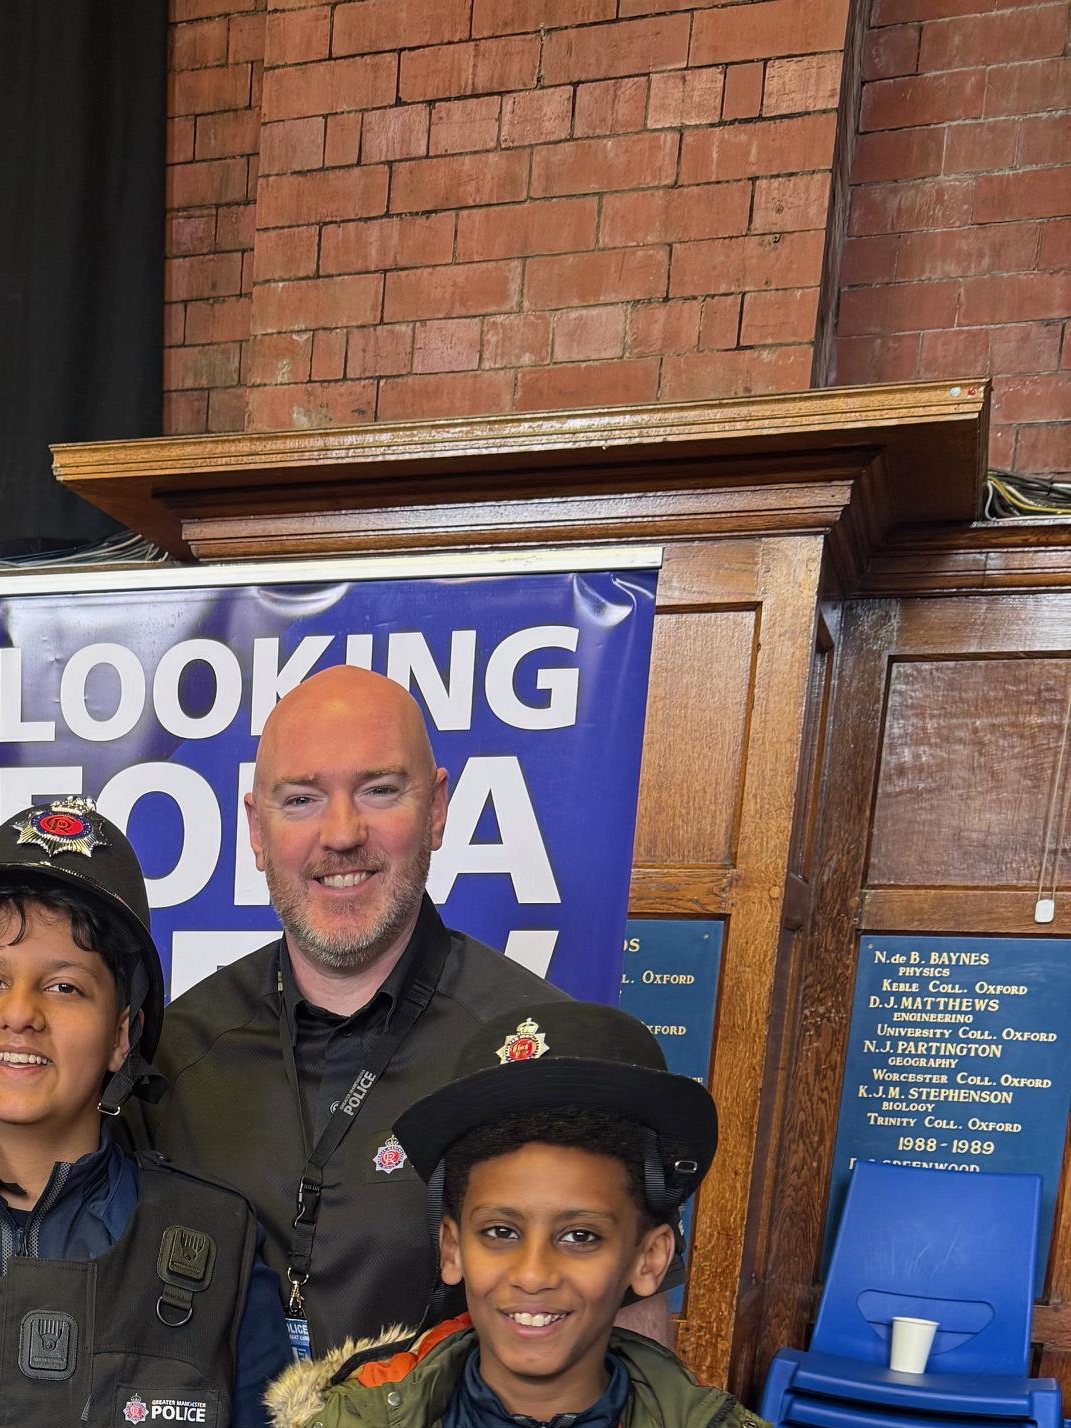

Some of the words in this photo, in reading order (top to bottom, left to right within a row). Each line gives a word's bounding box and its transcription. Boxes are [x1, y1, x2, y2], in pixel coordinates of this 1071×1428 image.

[424, 755, 562, 905] A
[929, 952, 989, 966] BAYNES
[642, 970, 695, 985] OXFORD
[898, 967, 950, 977] PHYSICS
[882, 979, 919, 992] KEBLE
[929, 980, 967, 994] COLL.
[975, 982, 1028, 996] OXFORD
[893, 1012, 973, 1024] ENGINEERING
[647, 1025, 687, 1036] XFORD
[876, 1024, 952, 1038] UNIVERSITY
[958, 1027, 996, 1040] COLL.
[1002, 1028, 1057, 1043] OXFORD
[888, 1057, 959, 1069] GEOGRAPHY
[872, 1069, 949, 1084] WORCESTER
[956, 1072, 996, 1086] COLL.
[1000, 1075, 1052, 1089] OXFORD
[343, 1070, 377, 1116] POLICE
[881, 1101, 936, 1112] BIOLOGY
[866, 1112, 917, 1127] TRINITY
[924, 1116, 962, 1130] COLL.
[968, 1118, 1022, 1133] OXFORD
[286, 1323, 309, 1335] LICE
[151, 1405, 206, 1423] POLICE
